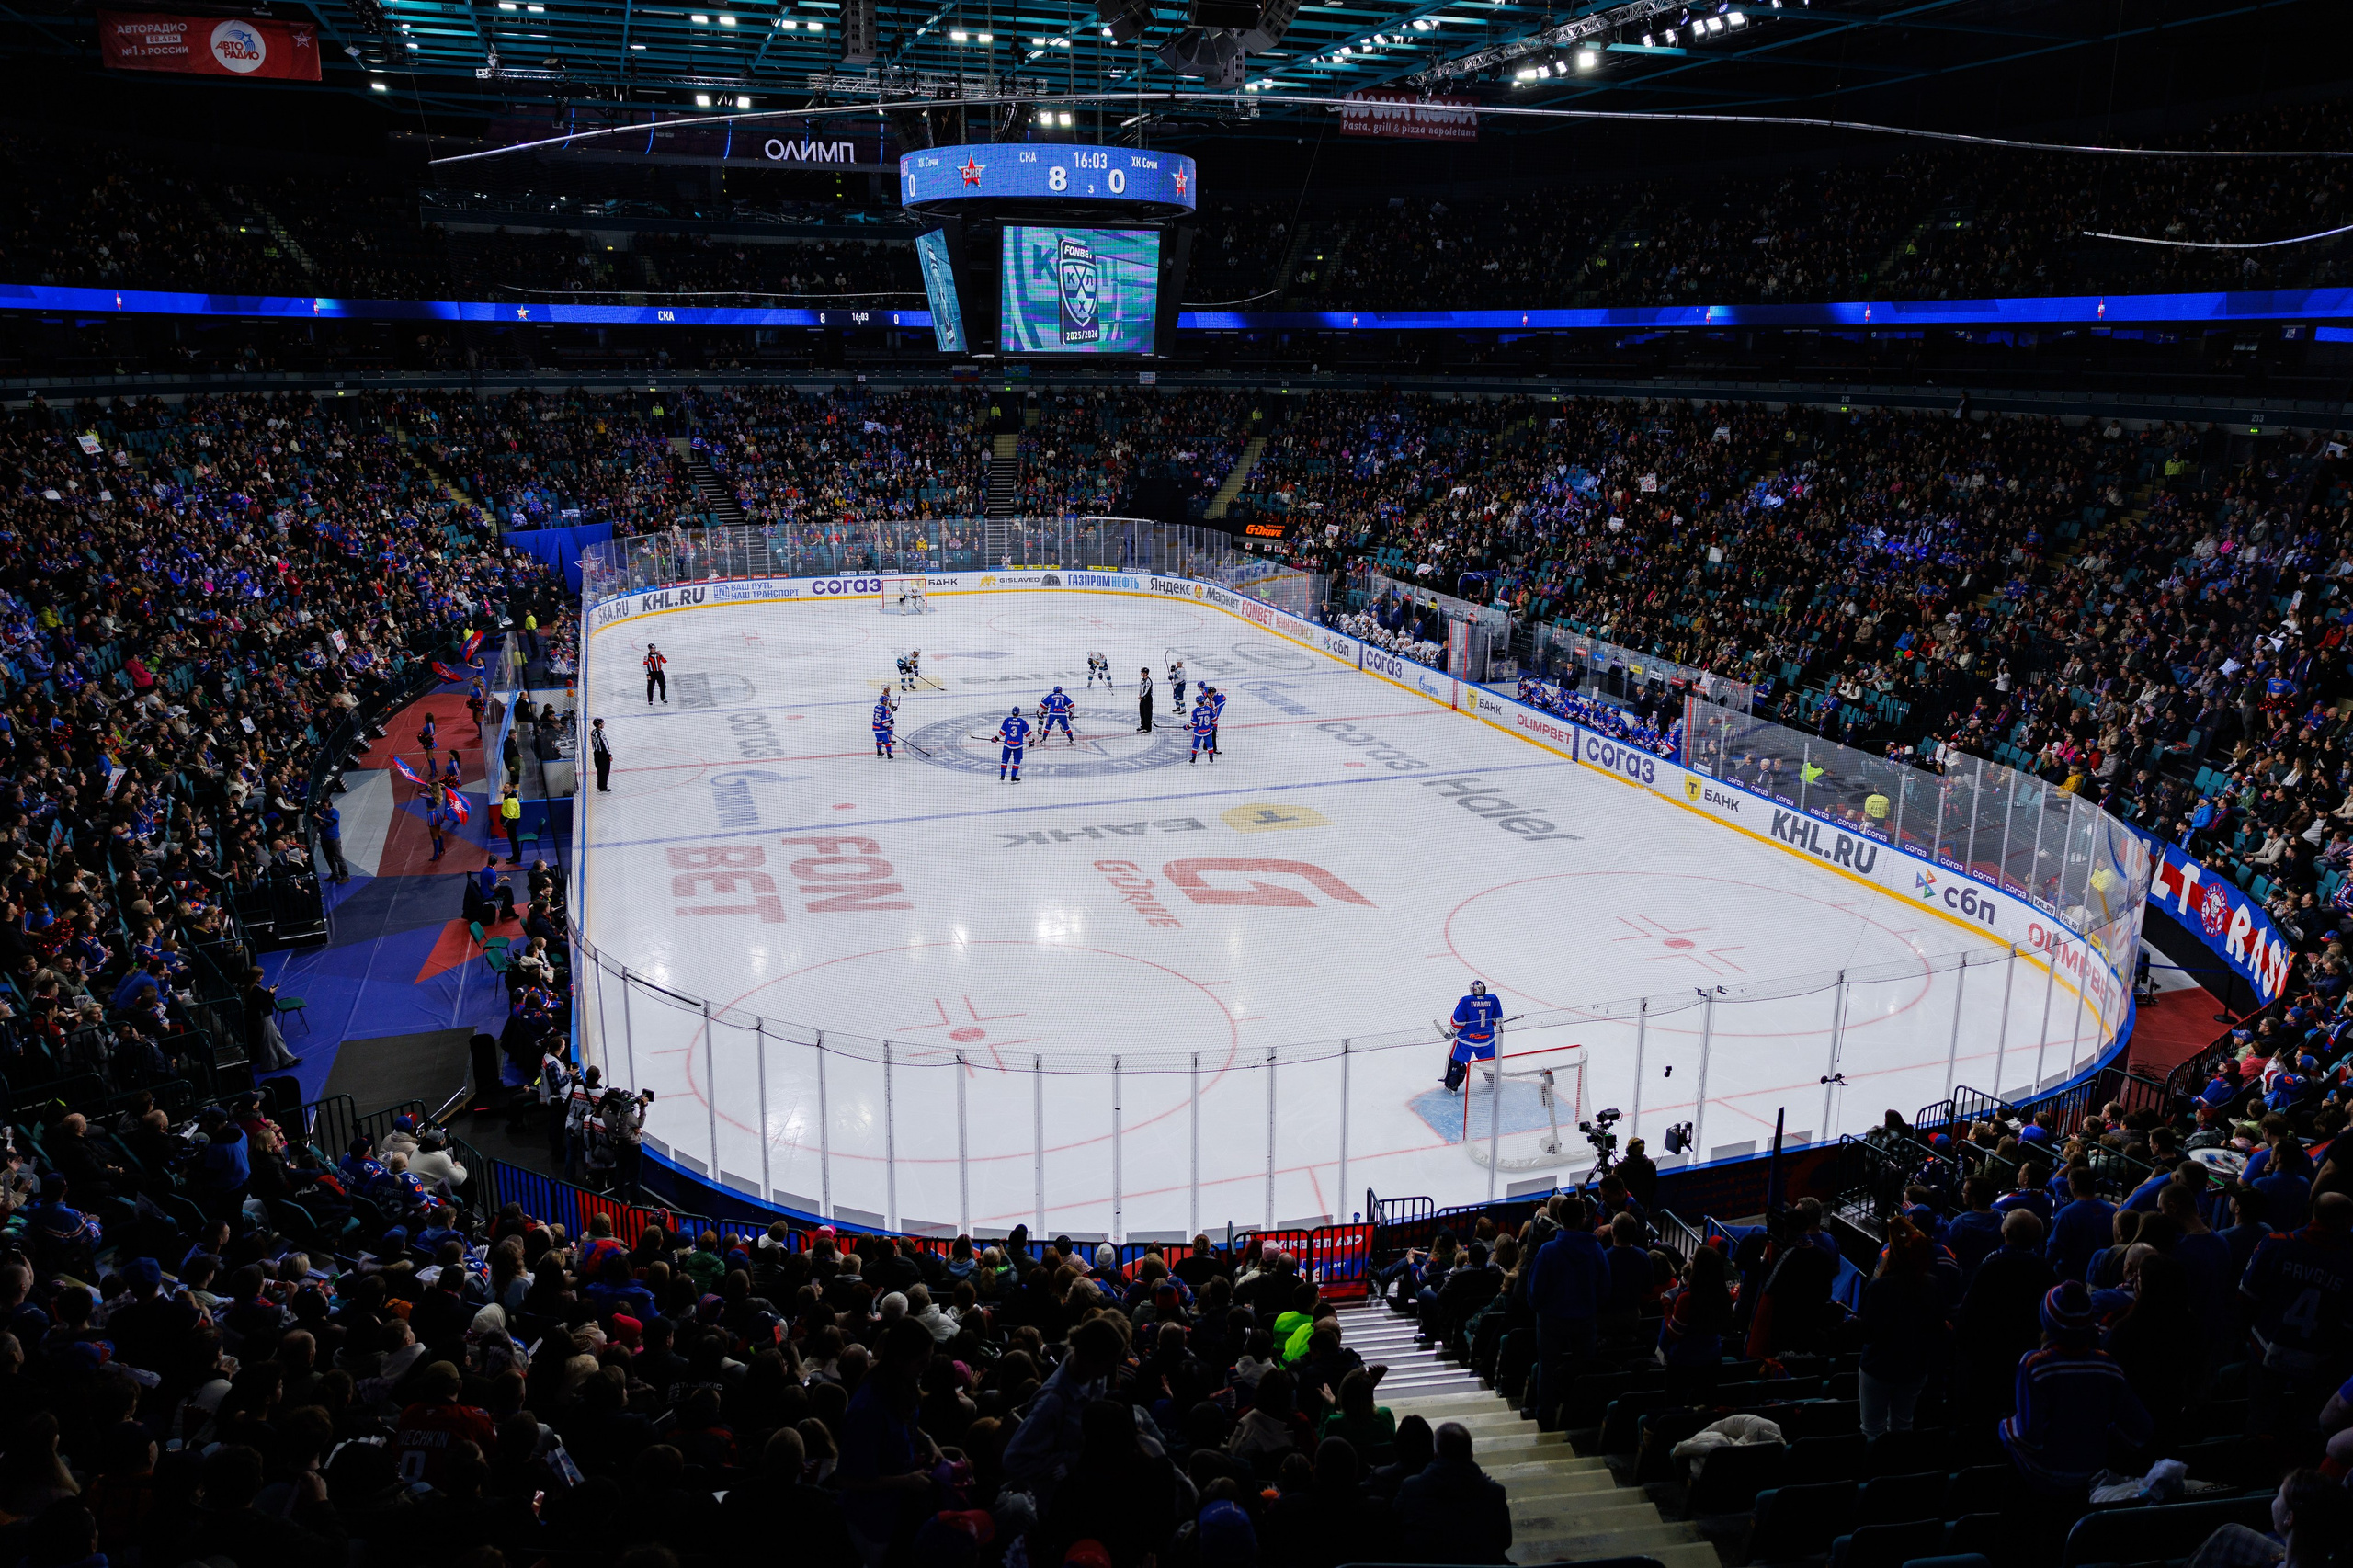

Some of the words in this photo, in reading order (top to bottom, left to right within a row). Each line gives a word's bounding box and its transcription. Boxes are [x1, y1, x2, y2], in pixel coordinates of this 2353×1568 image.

[117, 22, 188, 35] АВТОРАДИО
[122, 45, 138, 56] №1
[148, 45, 188, 55] РОССИИ
[215, 40, 244, 51] АВТО
[223, 50, 259, 61] РАДИО
[1373, 121, 1392, 135] grill
[1392, 123, 1400, 133] &
[1402, 123, 1426, 135] pizza
[1428, 126, 1476, 138] napoletana
[764, 138, 855, 163] ОЛИМП
[1019, 152, 1037, 163] СКА
[1074, 152, 1108, 169] 16:03
[1131, 155, 1141, 168] ХК
[1142, 157, 1158, 170] Сочи
[908, 173, 916, 198] 0
[1048, 165, 1068, 192] 8
[1108, 169, 1125, 194] 0
[1087, 185, 1095, 194] 3
[1067, 272, 1075, 285] К
[1086, 273, 1094, 286] Л
[1078, 299, 1086, 313] Х
[657, 311, 675, 322] СКА
[820, 312, 825, 324] 8
[851, 312, 869, 322] 16:03
[893, 314, 899, 324] 0
[1066, 329, 1098, 341] 2025/2026
[2251, 414, 2265, 423] 213
[731, 583, 749, 591] ВАШ
[751, 581, 773, 591] ПУТЬ
[812, 578, 881, 596] согаз
[928, 578, 958, 586] БАНК
[1067, 574, 1140, 589] ГАЗПРОМНЕФТЬ
[642, 586, 706, 612] KHL.RU
[731, 591, 750, 599] НАШ
[752, 588, 800, 598] ТРАНСПОРТ
[1150, 577, 1191, 596] Яндекс
[1206, 586, 1240, 610] Маркет
[597, 599, 630, 625] SKA.RU
[1242, 599, 1274, 627] FONBET
[1333, 638, 1349, 657] сбп
[1366, 650, 1403, 679] согаз
[1479, 698, 1502, 716] БАНК
[1197, 715, 1210, 727] 79
[1517, 713, 1573, 745] OLIMPBET
[1009, 726, 1018, 737] 3
[1586, 736, 1654, 784] согаз
[1727, 776, 1744, 788] согаз
[1750, 785, 1768, 797] согаз
[1703, 788, 1741, 813] БАНК
[1776, 794, 1794, 806] согаз
[1418, 778, 1585, 842] Haier
[1810, 807, 1830, 820] согаз
[998, 816, 1209, 848] БАНК
[1837, 818, 1858, 831] согаз
[1770, 808, 1878, 874] KHL.RU
[1867, 829, 1888, 842] согаз
[1904, 843, 1927, 858] согаз
[1940, 857, 1963, 871] согаз
[781, 835, 915, 913] FON
[1972, 869, 1996, 885] согаз
[665, 845, 787, 924] BET
[2005, 883, 2027, 899] согаз
[1944, 886, 1996, 926] сбп
[2034, 897, 2055, 915] KHL.RU
[2060, 914, 2080, 931] KHL.RU
[2028, 922, 2117, 1012] OLIMPBET
[1478, 1009, 1486, 1028] 1
[2282, 1287, 2322, 1339] 4
